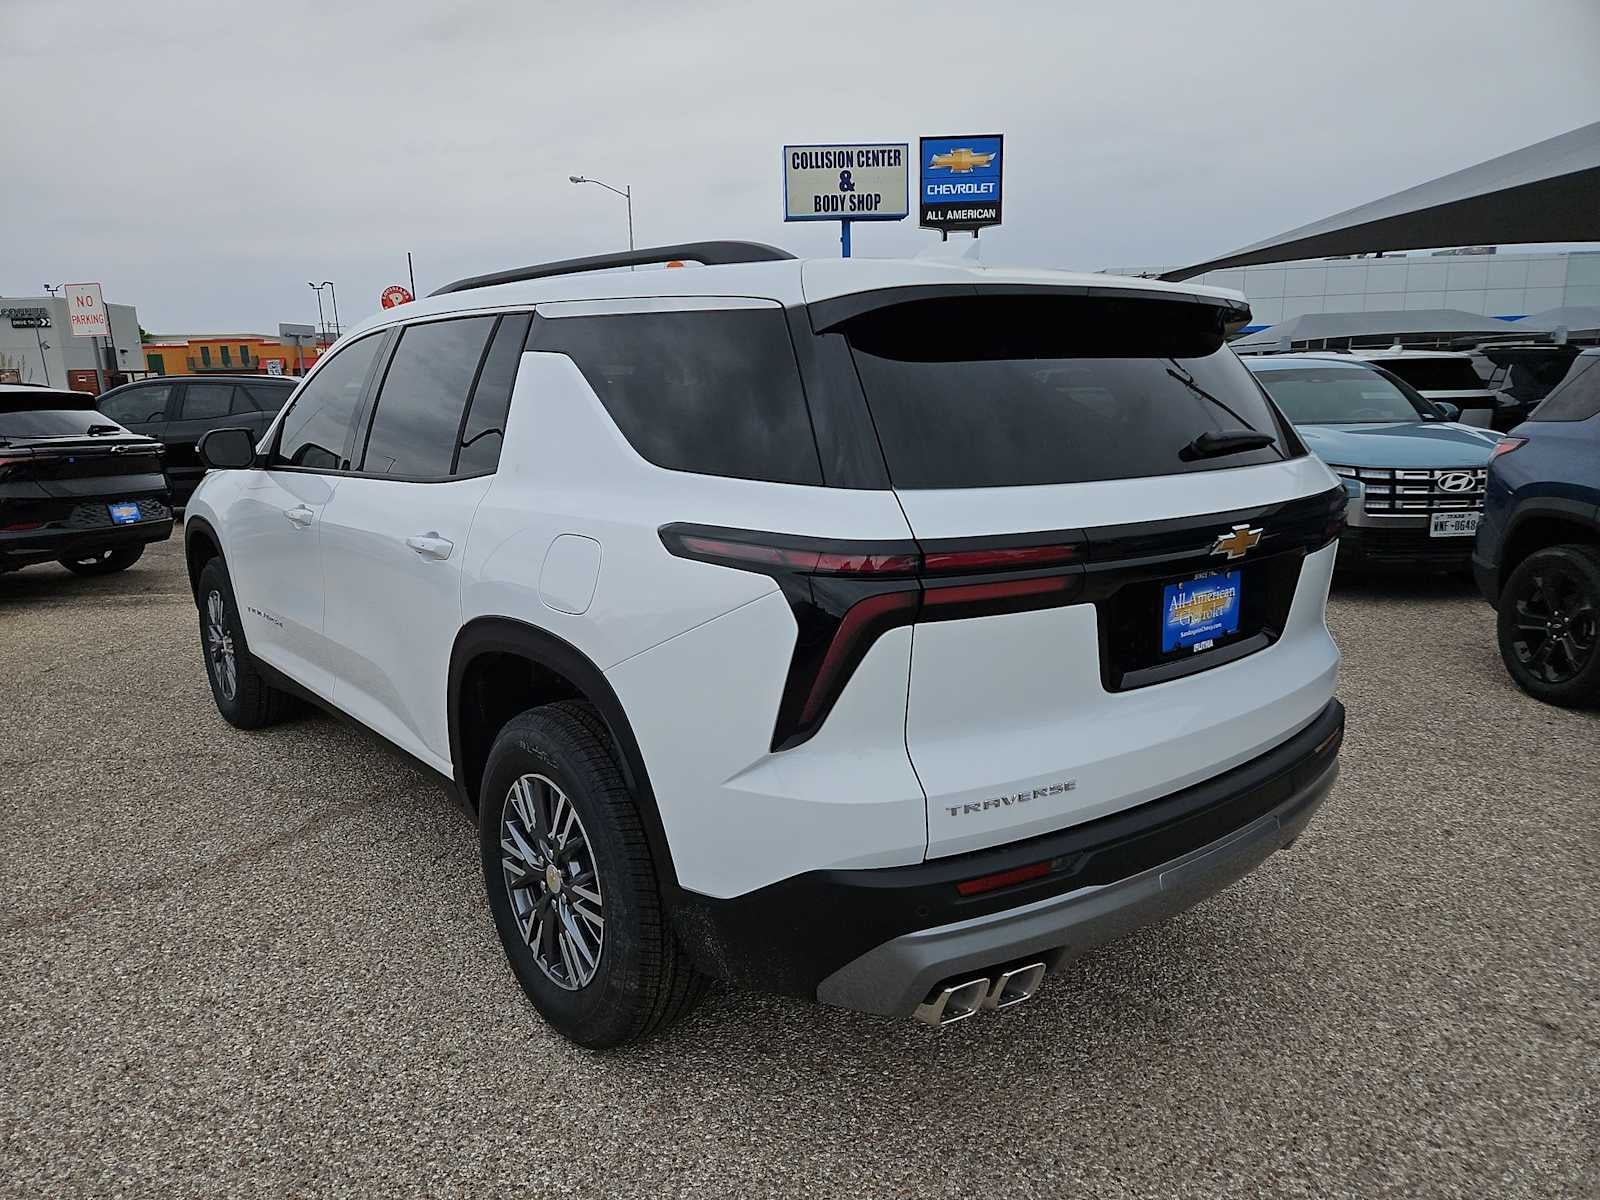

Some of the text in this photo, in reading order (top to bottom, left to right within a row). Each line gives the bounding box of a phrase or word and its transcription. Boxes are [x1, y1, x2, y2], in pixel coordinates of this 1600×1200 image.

[791, 149, 902, 170] COLLISION CENTER
[839, 169, 855, 192] &
[927, 182, 996, 196] CHEVROLET
[813, 193, 882, 213] BODY SHOP
[926, 208, 996, 221] ALL AMERICAN
[76, 295, 94, 308] NO
[71, 314, 105, 325] PARKING
[1169, 586, 1236, 611] All American
[945, 780, 1077, 817] TRAVERSE
